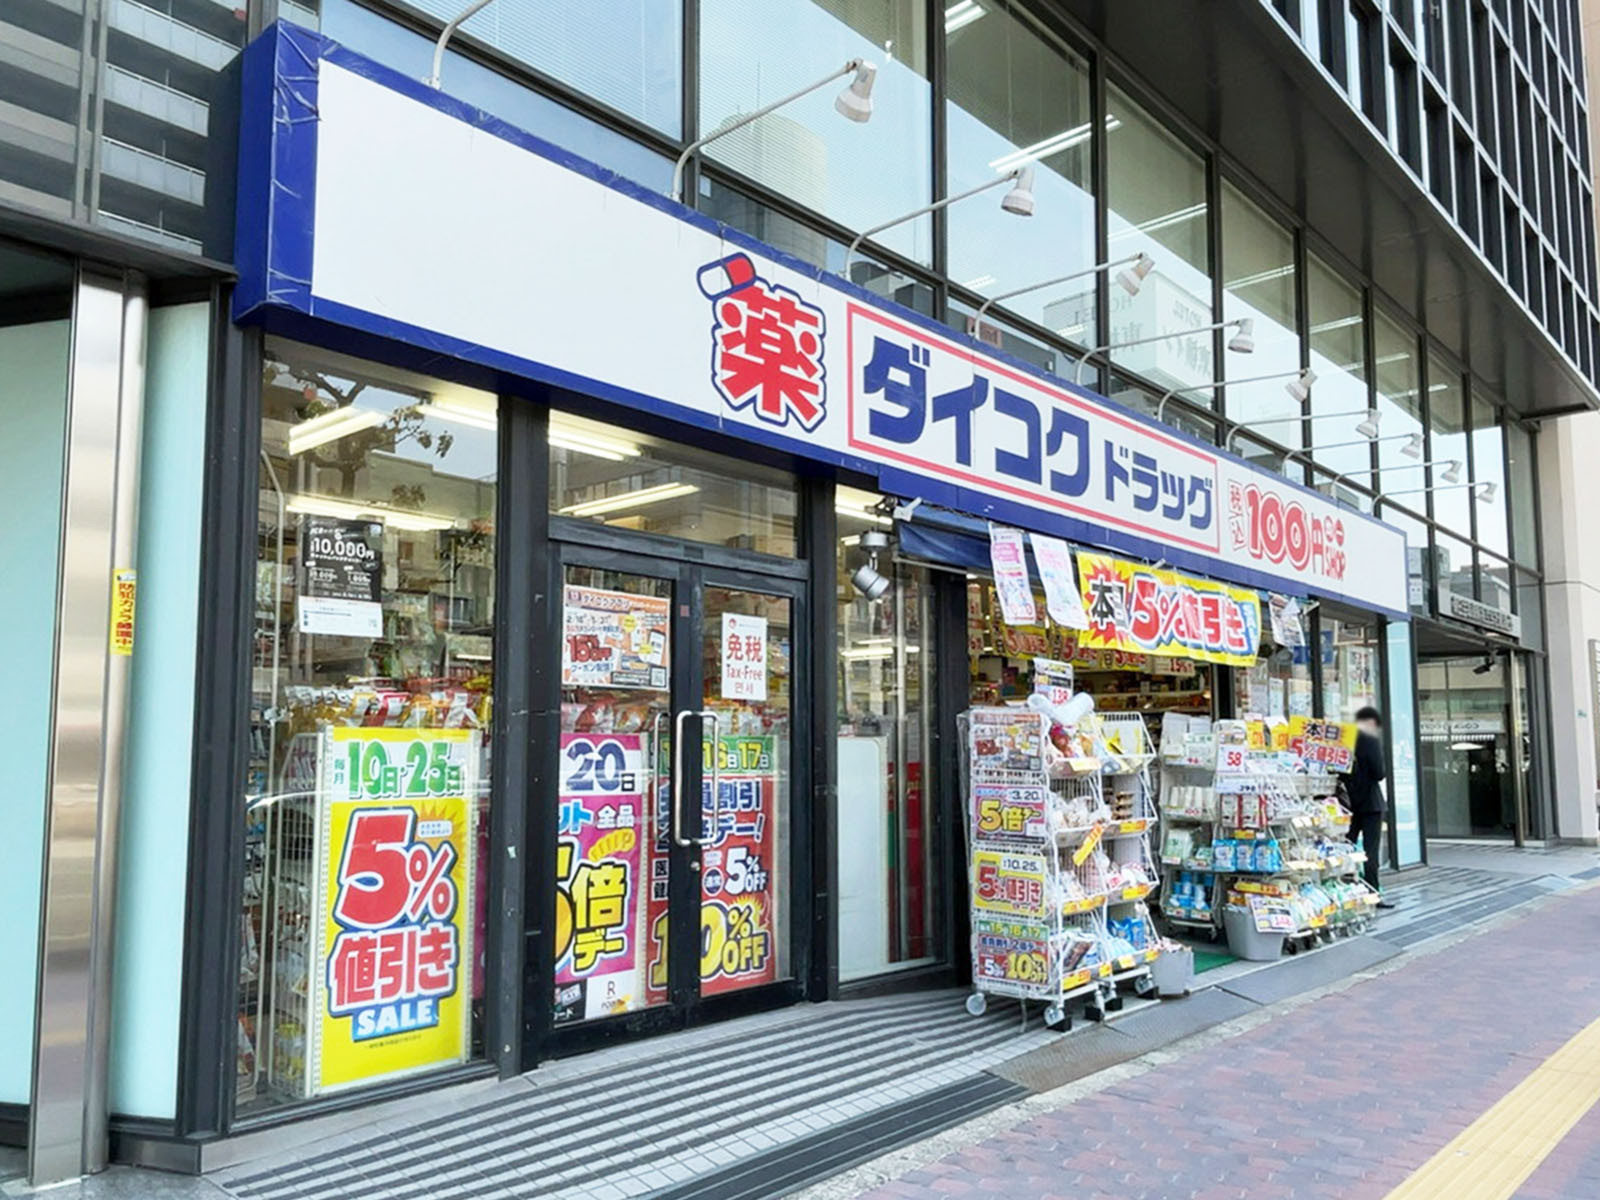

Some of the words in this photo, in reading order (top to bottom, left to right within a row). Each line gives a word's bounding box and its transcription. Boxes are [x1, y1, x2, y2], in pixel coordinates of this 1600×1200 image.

[716, 282, 824, 427] 薬
[863, 335, 1090, 499] ダイコク
[1103, 438, 1214, 532] ドラッグ
[726, 633, 763, 662] 免税
[1306, 723, 1340, 740] 本日
[565, 741, 636, 792] 20日
[596, 804, 635, 829] 全品
[338, 814, 452, 925] 5%
[333, 926, 451, 1007] 値引き
[356, 998, 434, 1037] SALE
